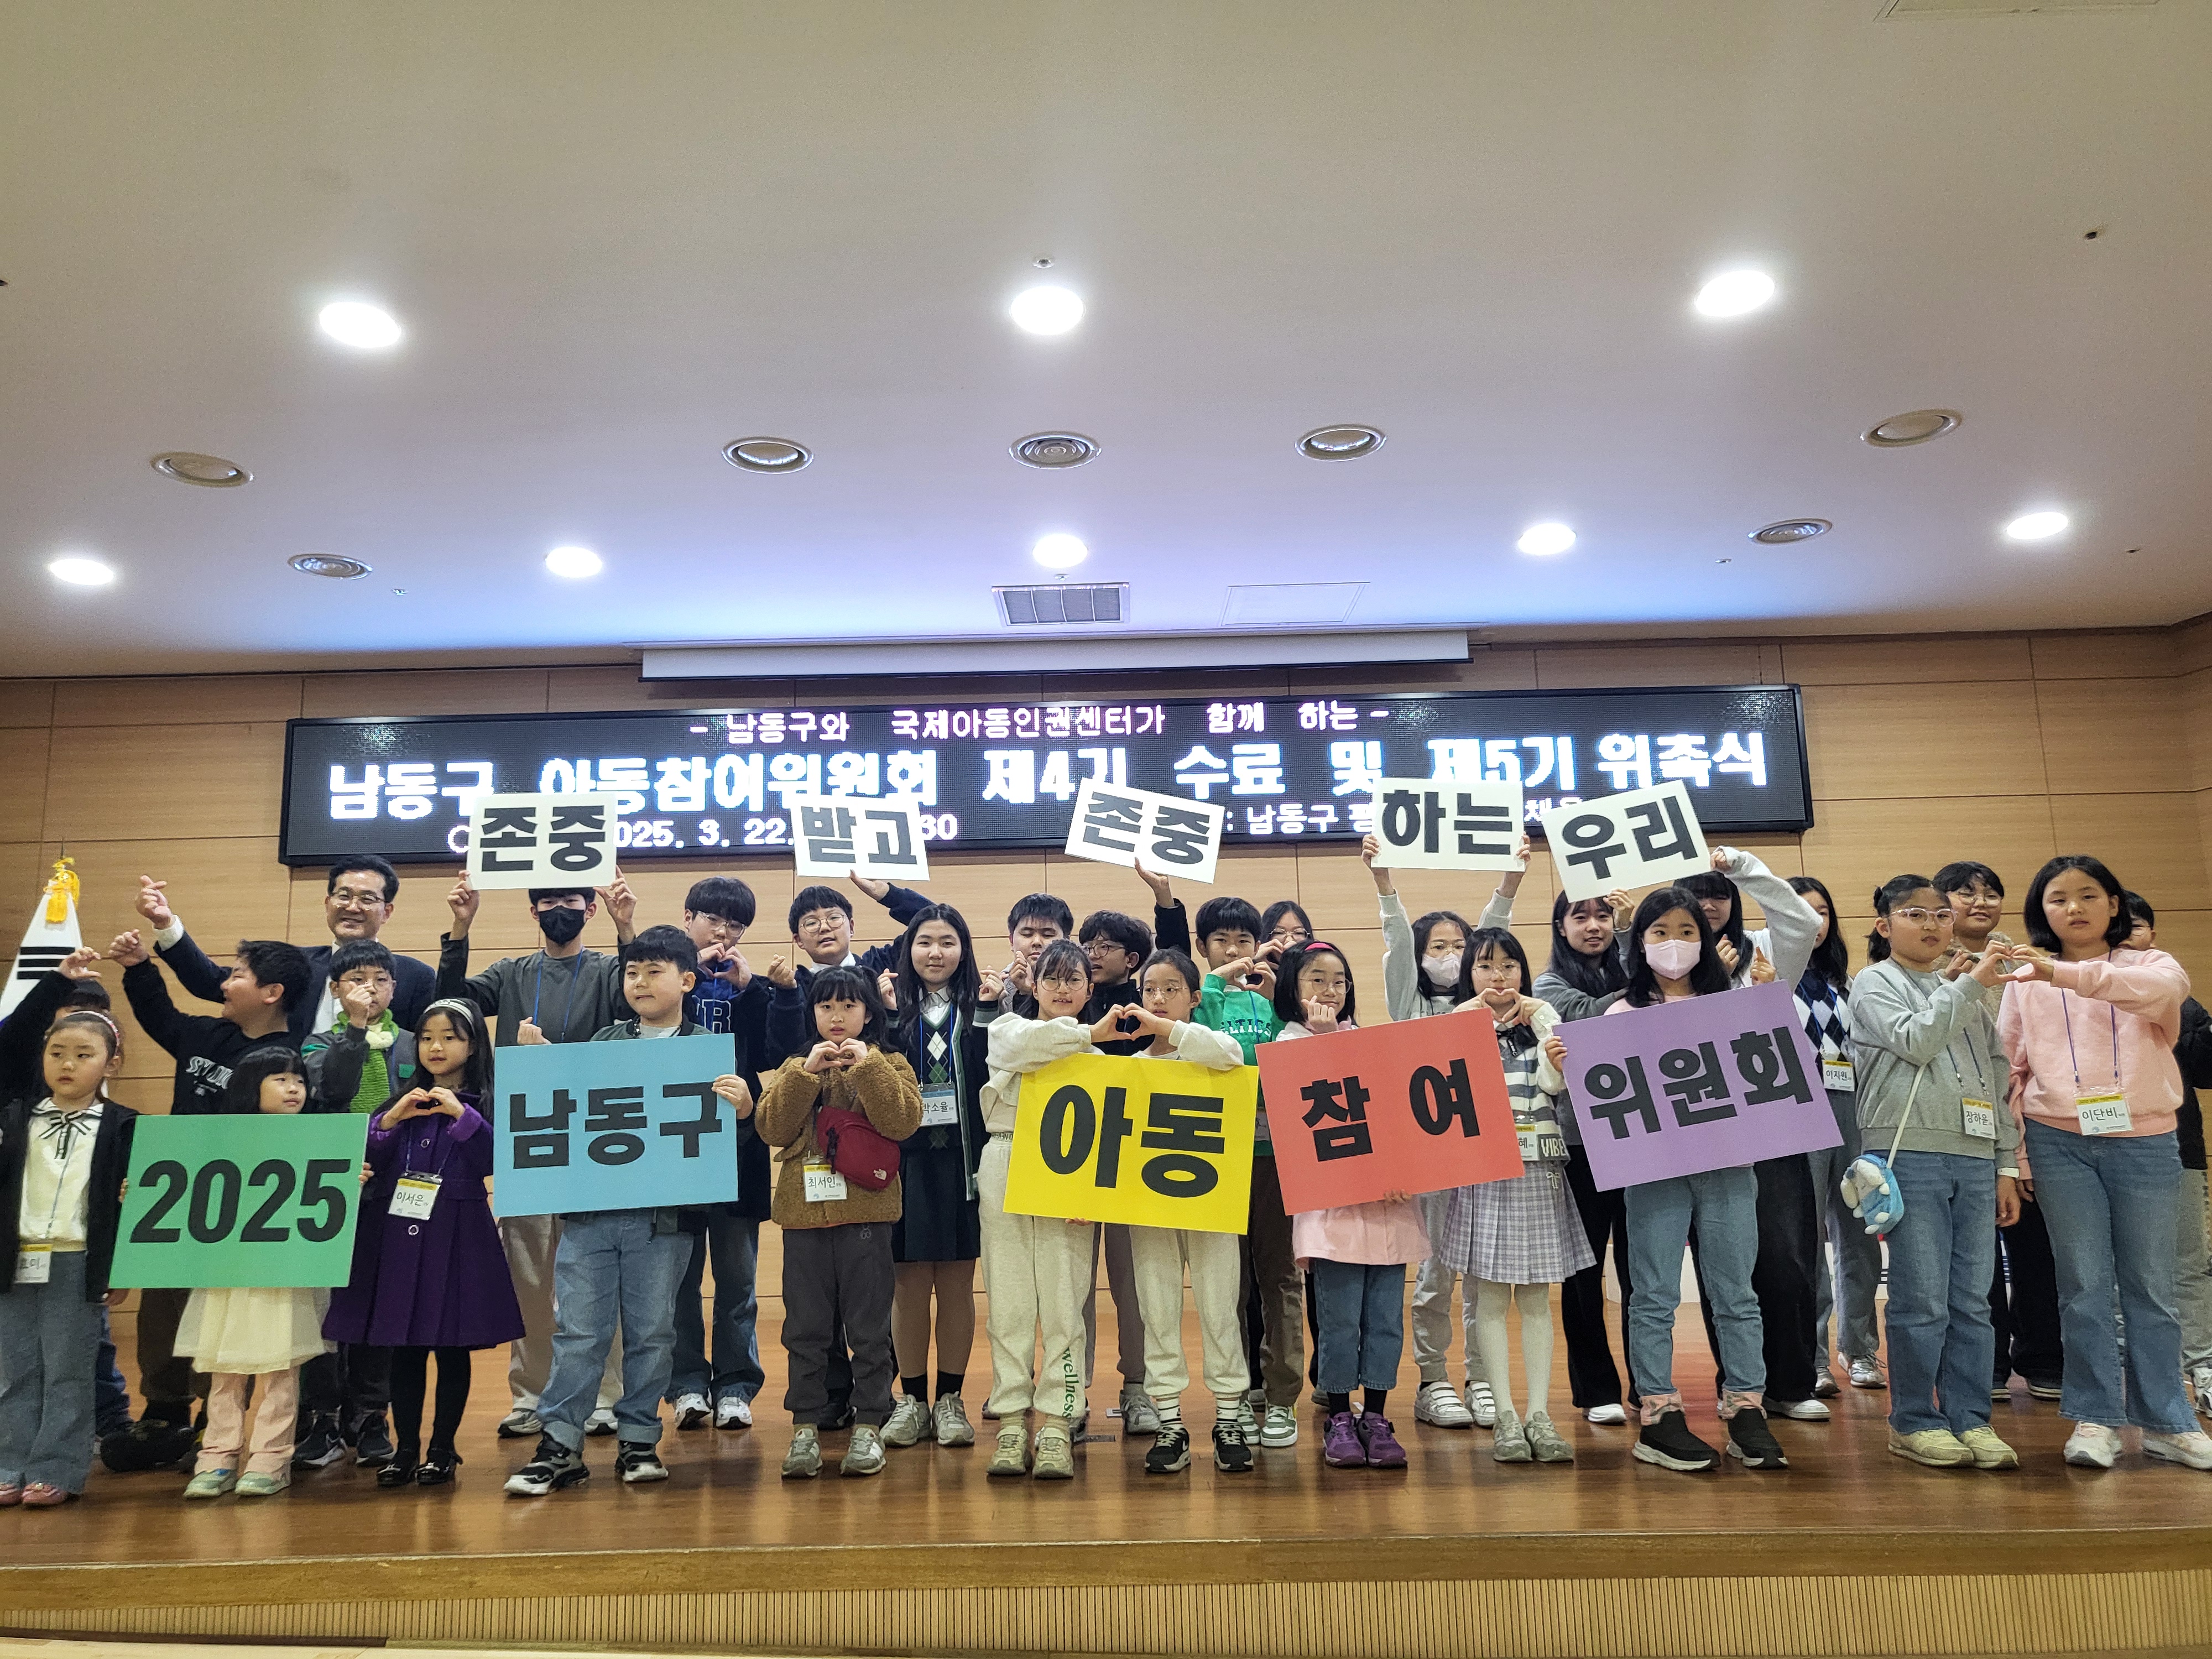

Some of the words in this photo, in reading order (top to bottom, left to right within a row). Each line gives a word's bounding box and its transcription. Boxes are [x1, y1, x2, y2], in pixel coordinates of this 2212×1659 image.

[727, 712, 850, 744] 남동구와
[891, 705, 1165, 739] 국제아동인권센터가
[1206, 702, 1264, 732] 함께
[1298, 701, 1358, 731] 하는
[329, 761, 494, 820] 남동구
[538, 748, 937, 813] 아동참여위원회
[982, 747, 1127, 804] 제4기
[1173, 743, 1286, 800] 수료
[1331, 740, 1384, 797] 및
[1427, 736, 1575, 791] 제5기
[1597, 732, 1767, 789] 위촉식
[479, 805, 605, 872] 존중
[613, 820, 685, 848] 025.
[698, 818, 731, 847] 3.
[1246, 804, 1339, 835] 남동구
[801, 806, 918, 864] 받고
[1082, 791, 1211, 865] 존중
[1381, 789, 1514, 855] 하는
[1561, 795, 1699, 880] 우리
[1584, 1026, 1814, 1140] 위원회
[2082, 1107, 2117, 1121] 이단비
[509, 1081, 723, 1170] 남동구
[1039, 1084, 1226, 1198] 아동
[129, 1159, 352, 1244] 2025
[397, 1191, 424, 1206] 이서은
[808, 1176, 836, 1188] 최서인
[1062, 1347, 1079, 1419] wellness
